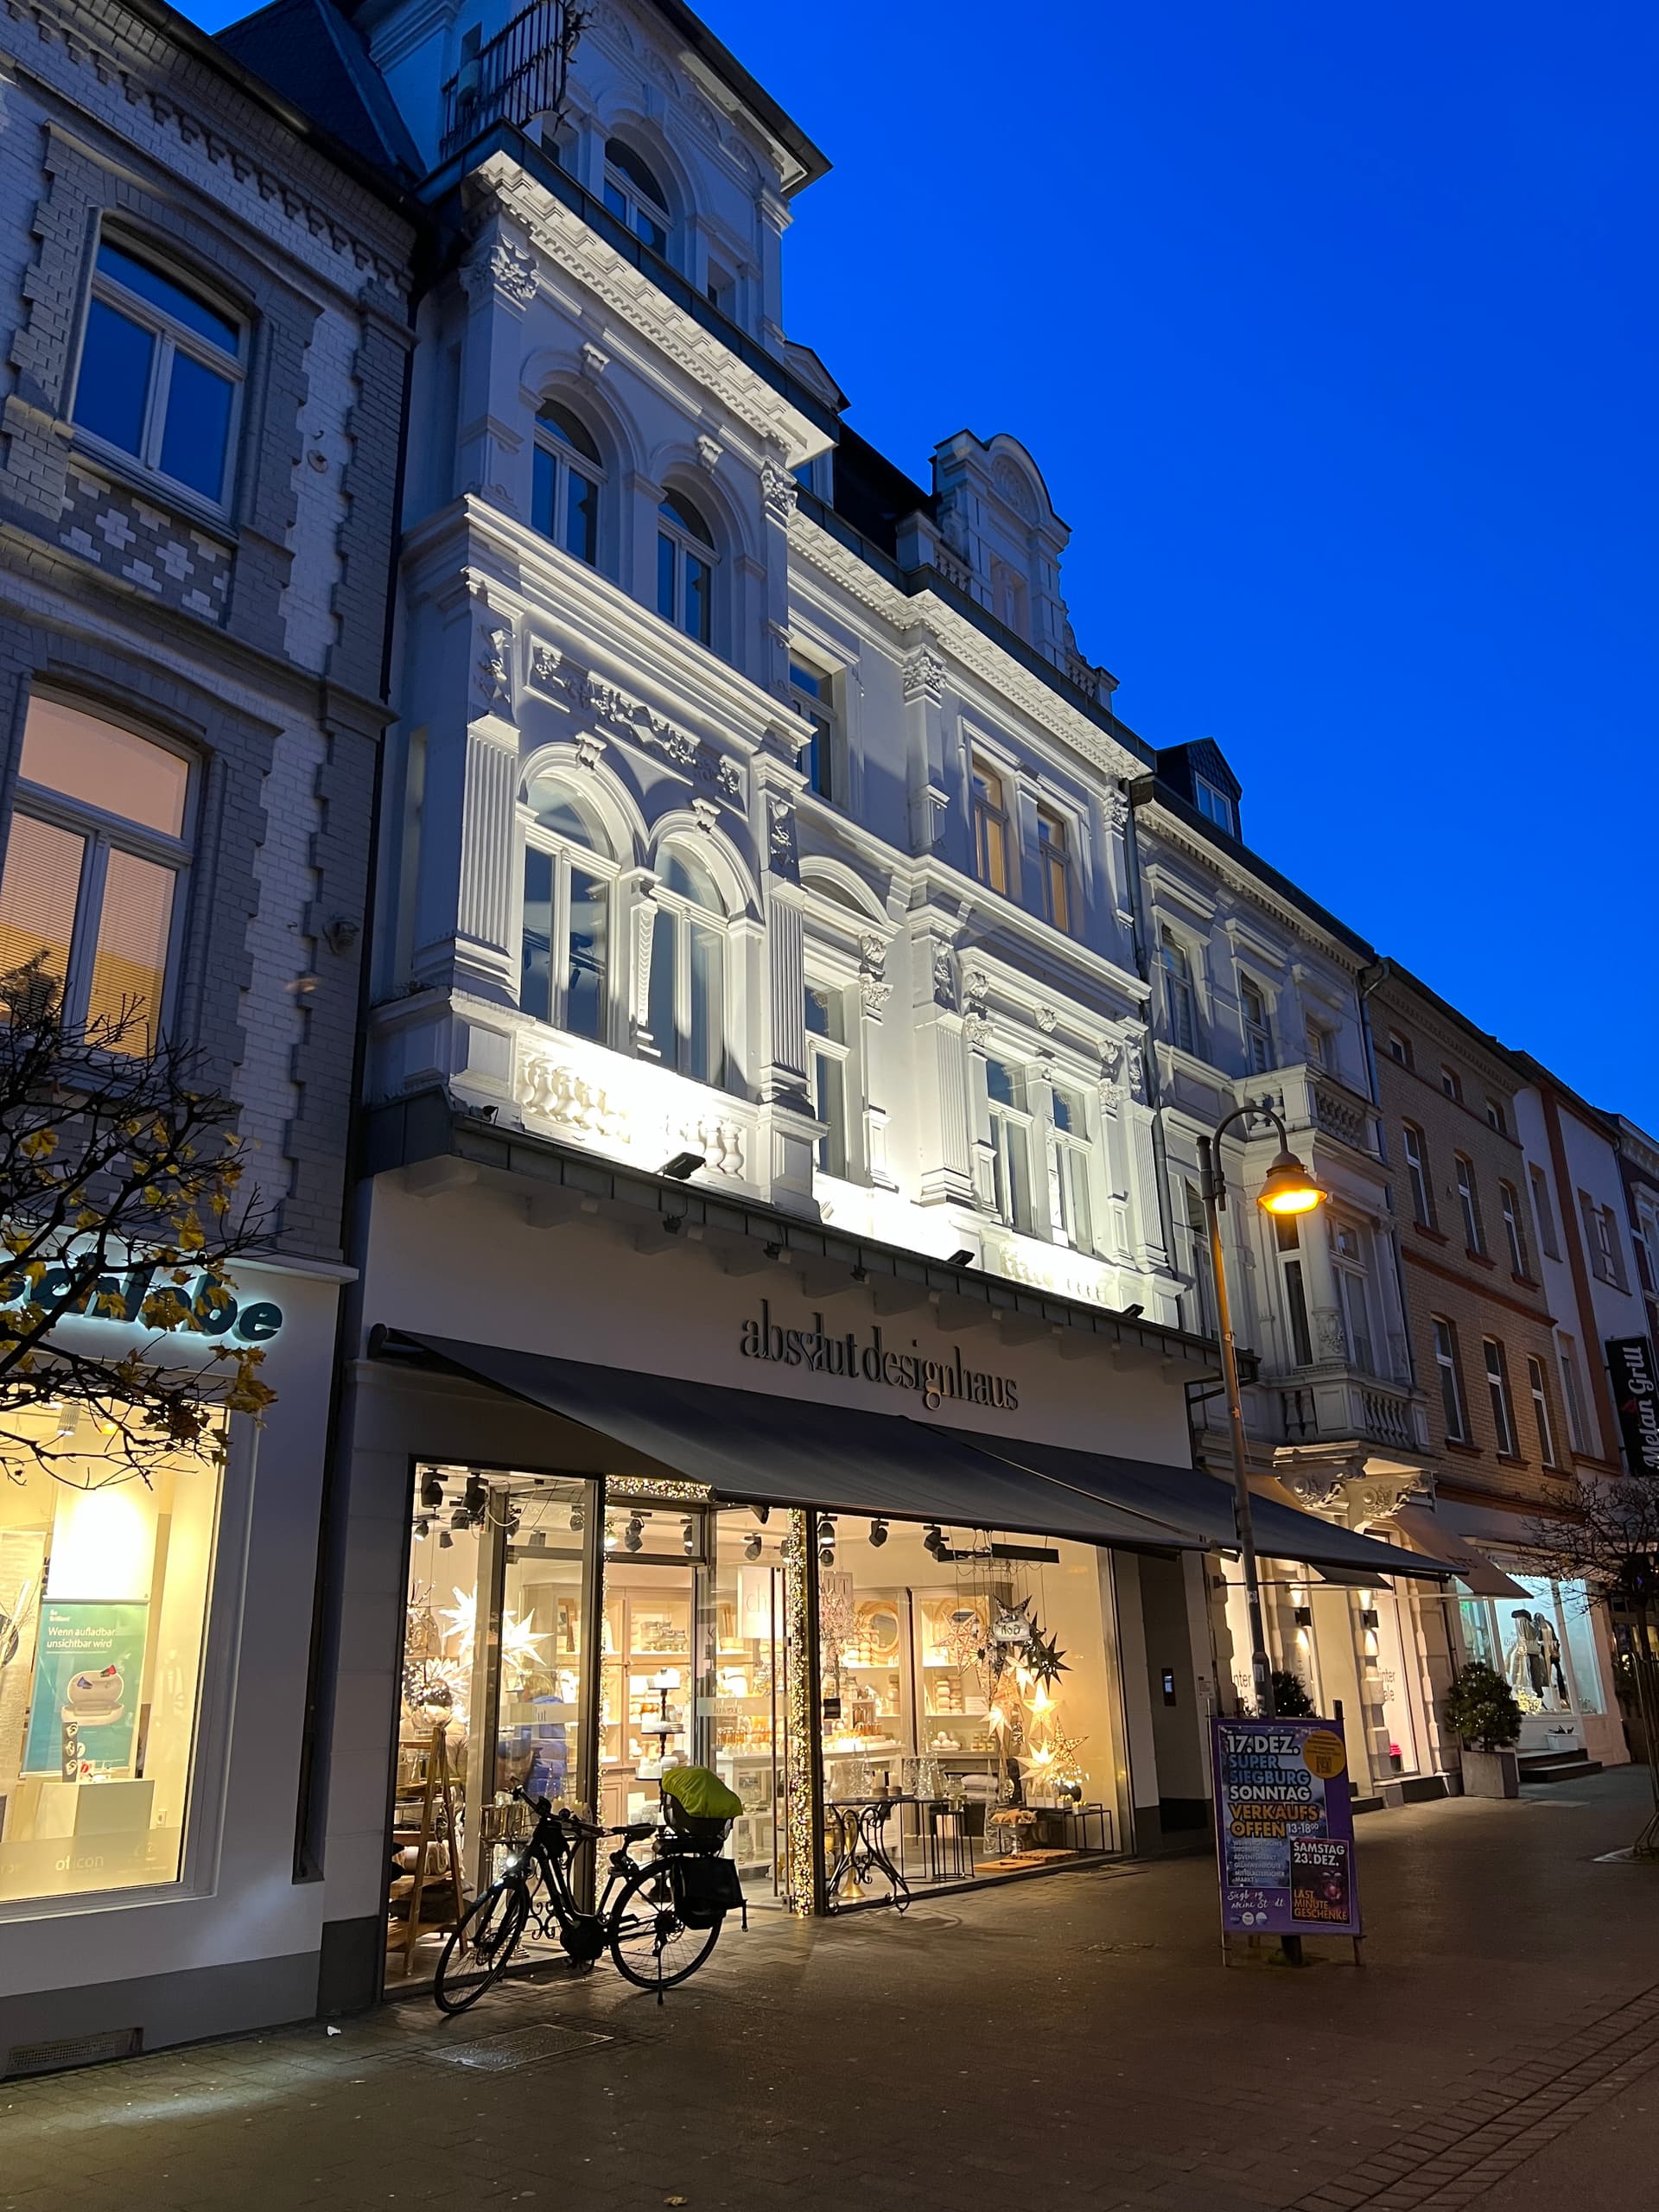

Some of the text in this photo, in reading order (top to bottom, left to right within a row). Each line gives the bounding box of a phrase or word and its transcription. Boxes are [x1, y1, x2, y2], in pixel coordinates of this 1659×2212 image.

[863, 1325, 1019, 1410] designhaus
[1623, 1346, 1655, 1395] Grill
[48, 1627, 116, 1637] Wenn aufladbar
[47, 1638, 112, 1649] unsichtbar wird
[1383, 1684, 1395, 1701] ale
[1229, 1754, 1278, 1769] SUPER
[1230, 1770, 1310, 1785] SIEGBURG
[1230, 1785, 1311, 1801] SONNTAG
[1229, 1804, 1319, 1821] VERKAUFS
[1230, 1820, 1286, 1837] OFFEN
[1294, 1841, 1345, 1855] SAMSTAG
[1294, 1889, 1314, 1899] LAST
[1294, 1899, 1328, 1910] MINUTE
[1294, 1908, 1348, 1920] GESCHENKE
